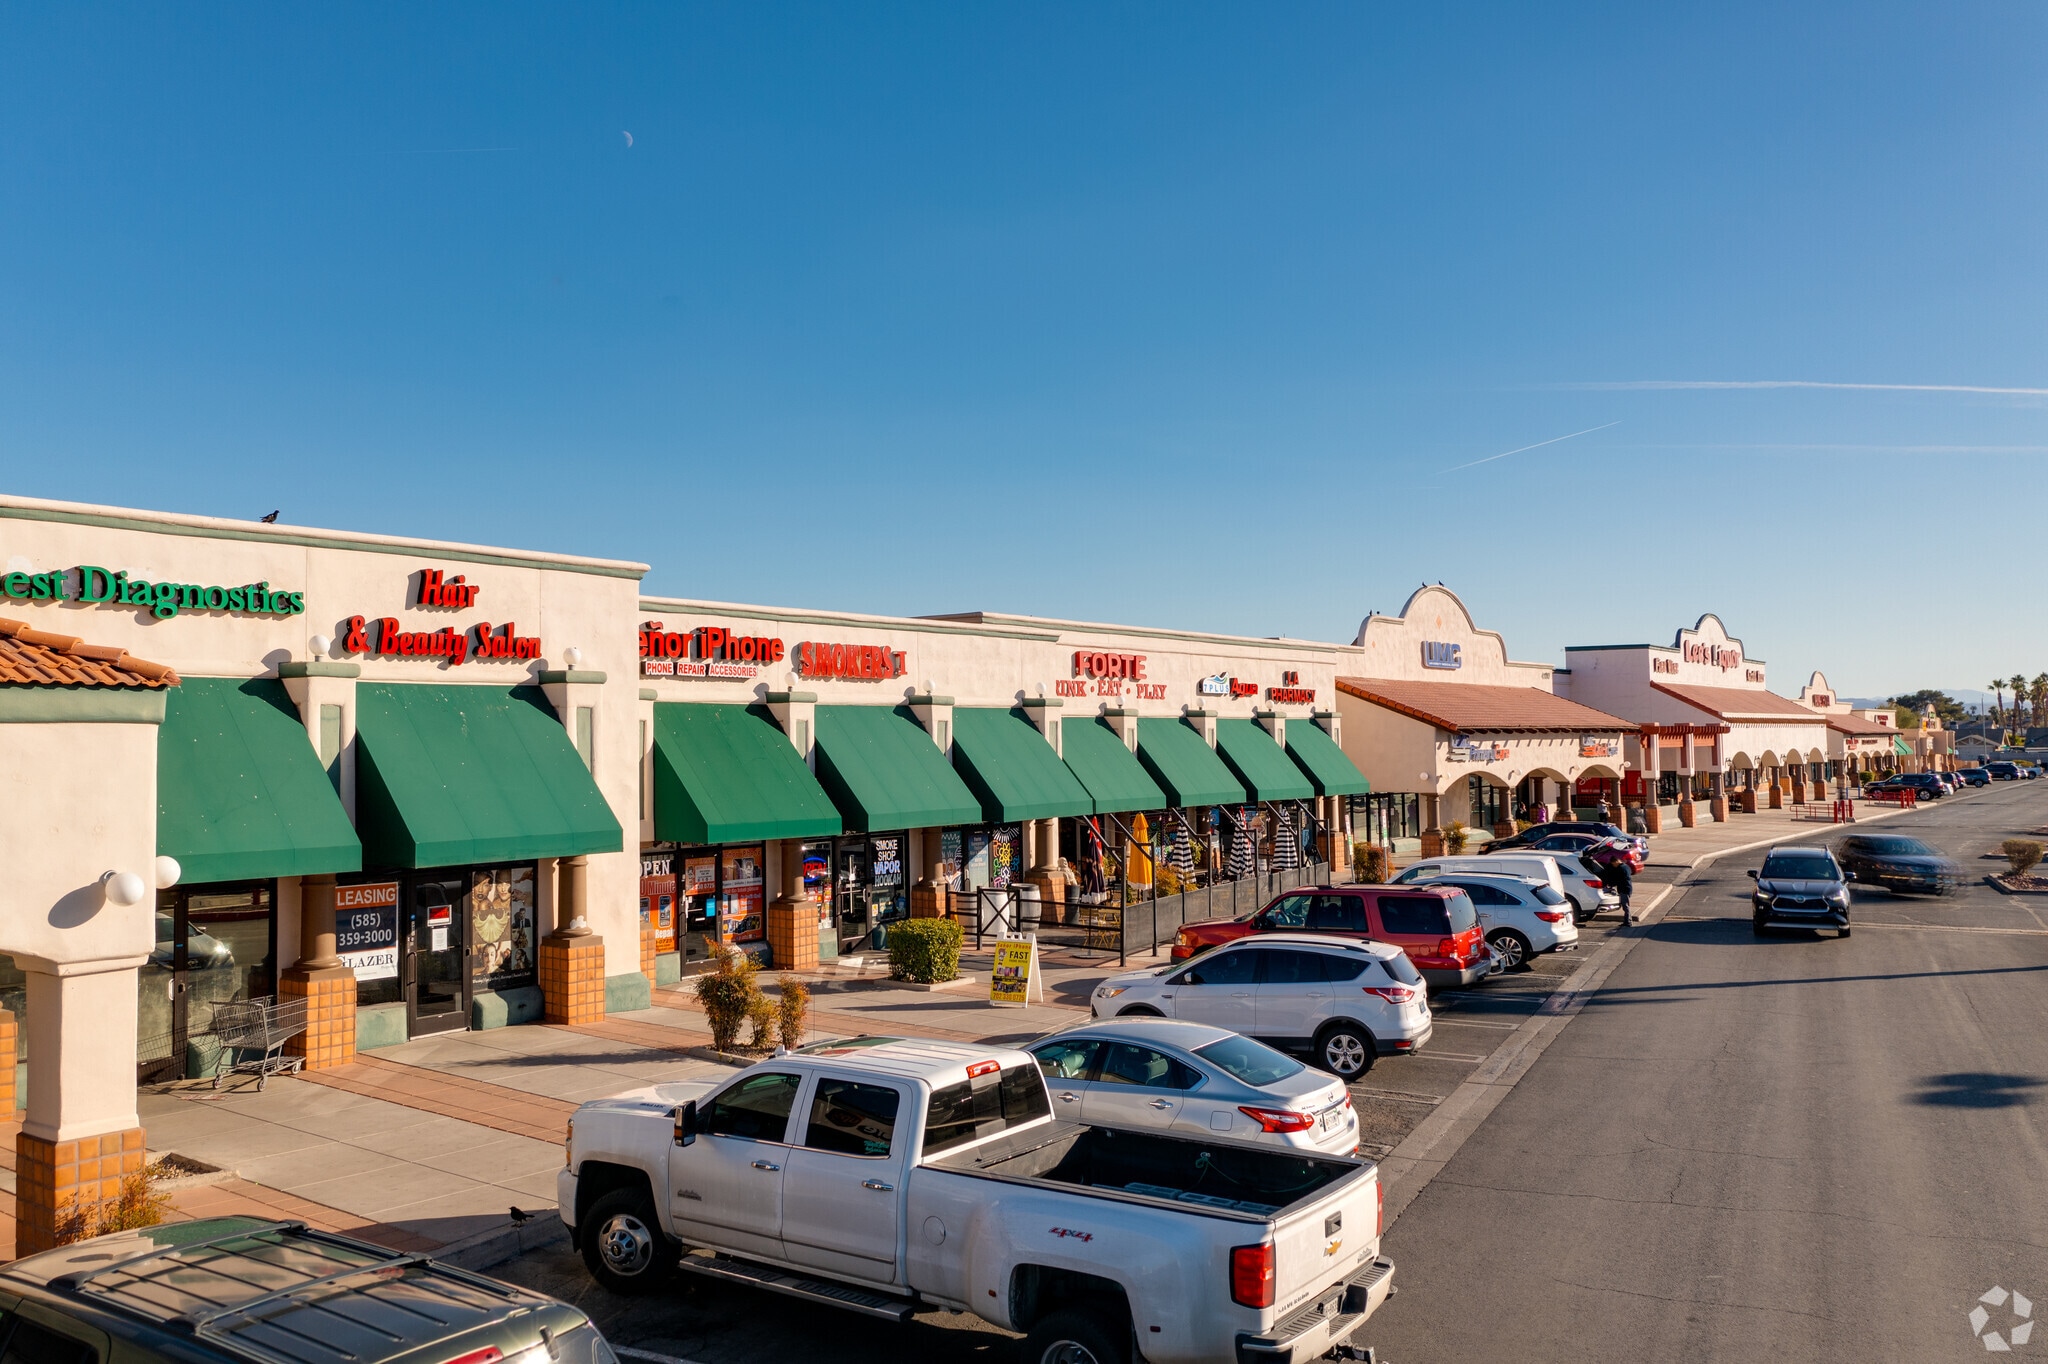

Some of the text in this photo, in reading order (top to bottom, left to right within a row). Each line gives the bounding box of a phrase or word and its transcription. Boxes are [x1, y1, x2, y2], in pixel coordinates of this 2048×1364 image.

[0, 565, 305, 619] est Diagnostics
[419, 569, 480, 607] Hair
[345, 615, 541, 665] & Beauty Salon
[701, 626, 785, 662] iPhone
[801, 641, 895, 679] SMOKERS
[1425, 641, 1461, 662] UMC
[1711, 645, 1742, 673] Liquor
[646, 662, 757, 678] PHONE REPAIR ACCESSORIES
[1075, 651, 1147, 680] FORTE
[1284, 671, 1299, 685] LA
[1097, 680, 1122, 696] EAT
[1136, 684, 1167, 700] PLAY
[1270, 688, 1316, 703] PHARMACY
[875, 840, 898, 851] SMOKE
[878, 851, 896, 861] SHOP
[874, 860, 900, 875] VAPOR
[648, 880, 676, 895] Minute
[874, 874, 902, 887] HOOKAH
[337, 888, 396, 906] LEASING
[351, 912, 381, 930] (585)
[339, 929, 392, 946] 359-3000
[655, 928, 675, 938] Repair
[1009, 951, 1029, 960] FAST
